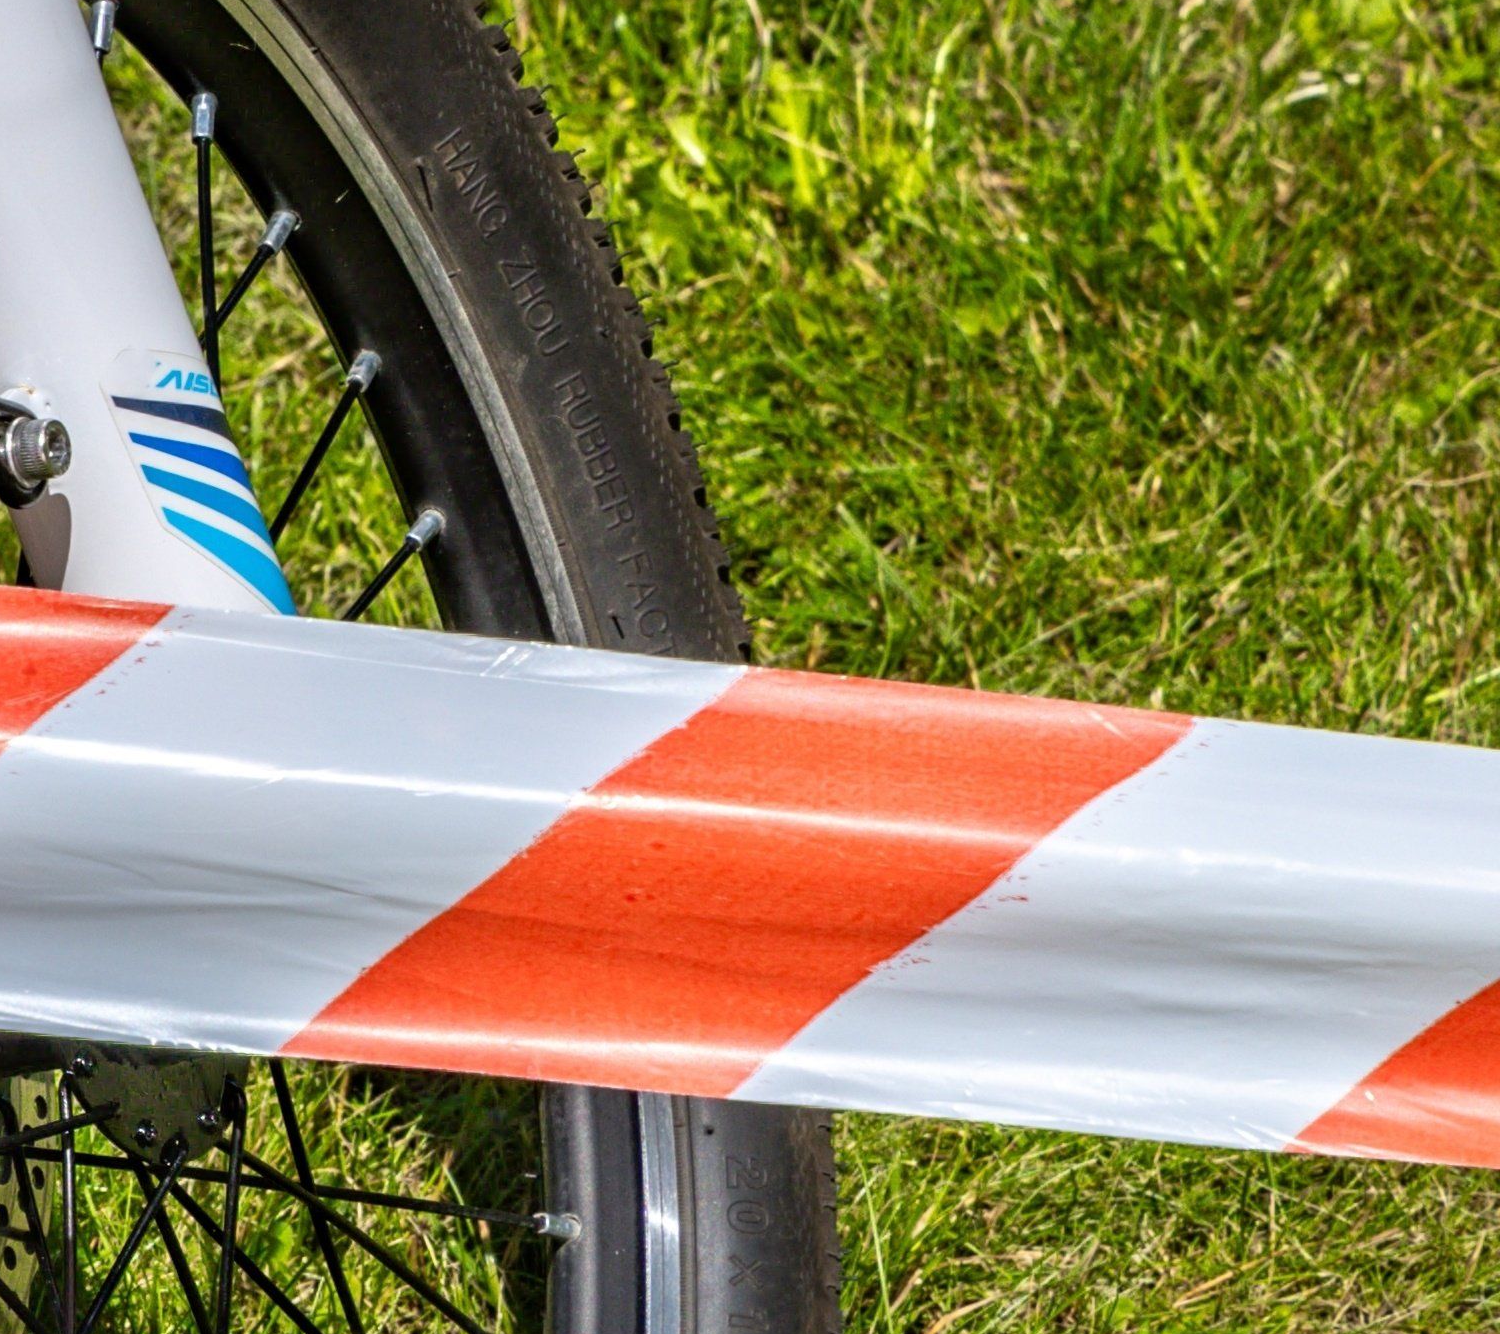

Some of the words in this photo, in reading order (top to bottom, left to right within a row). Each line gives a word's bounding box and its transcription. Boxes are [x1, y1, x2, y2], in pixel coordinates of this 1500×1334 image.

[434, 127, 510, 239] HANG
[499, 257, 570, 358] ZHOU
[554, 370, 634, 531] RUBBER
